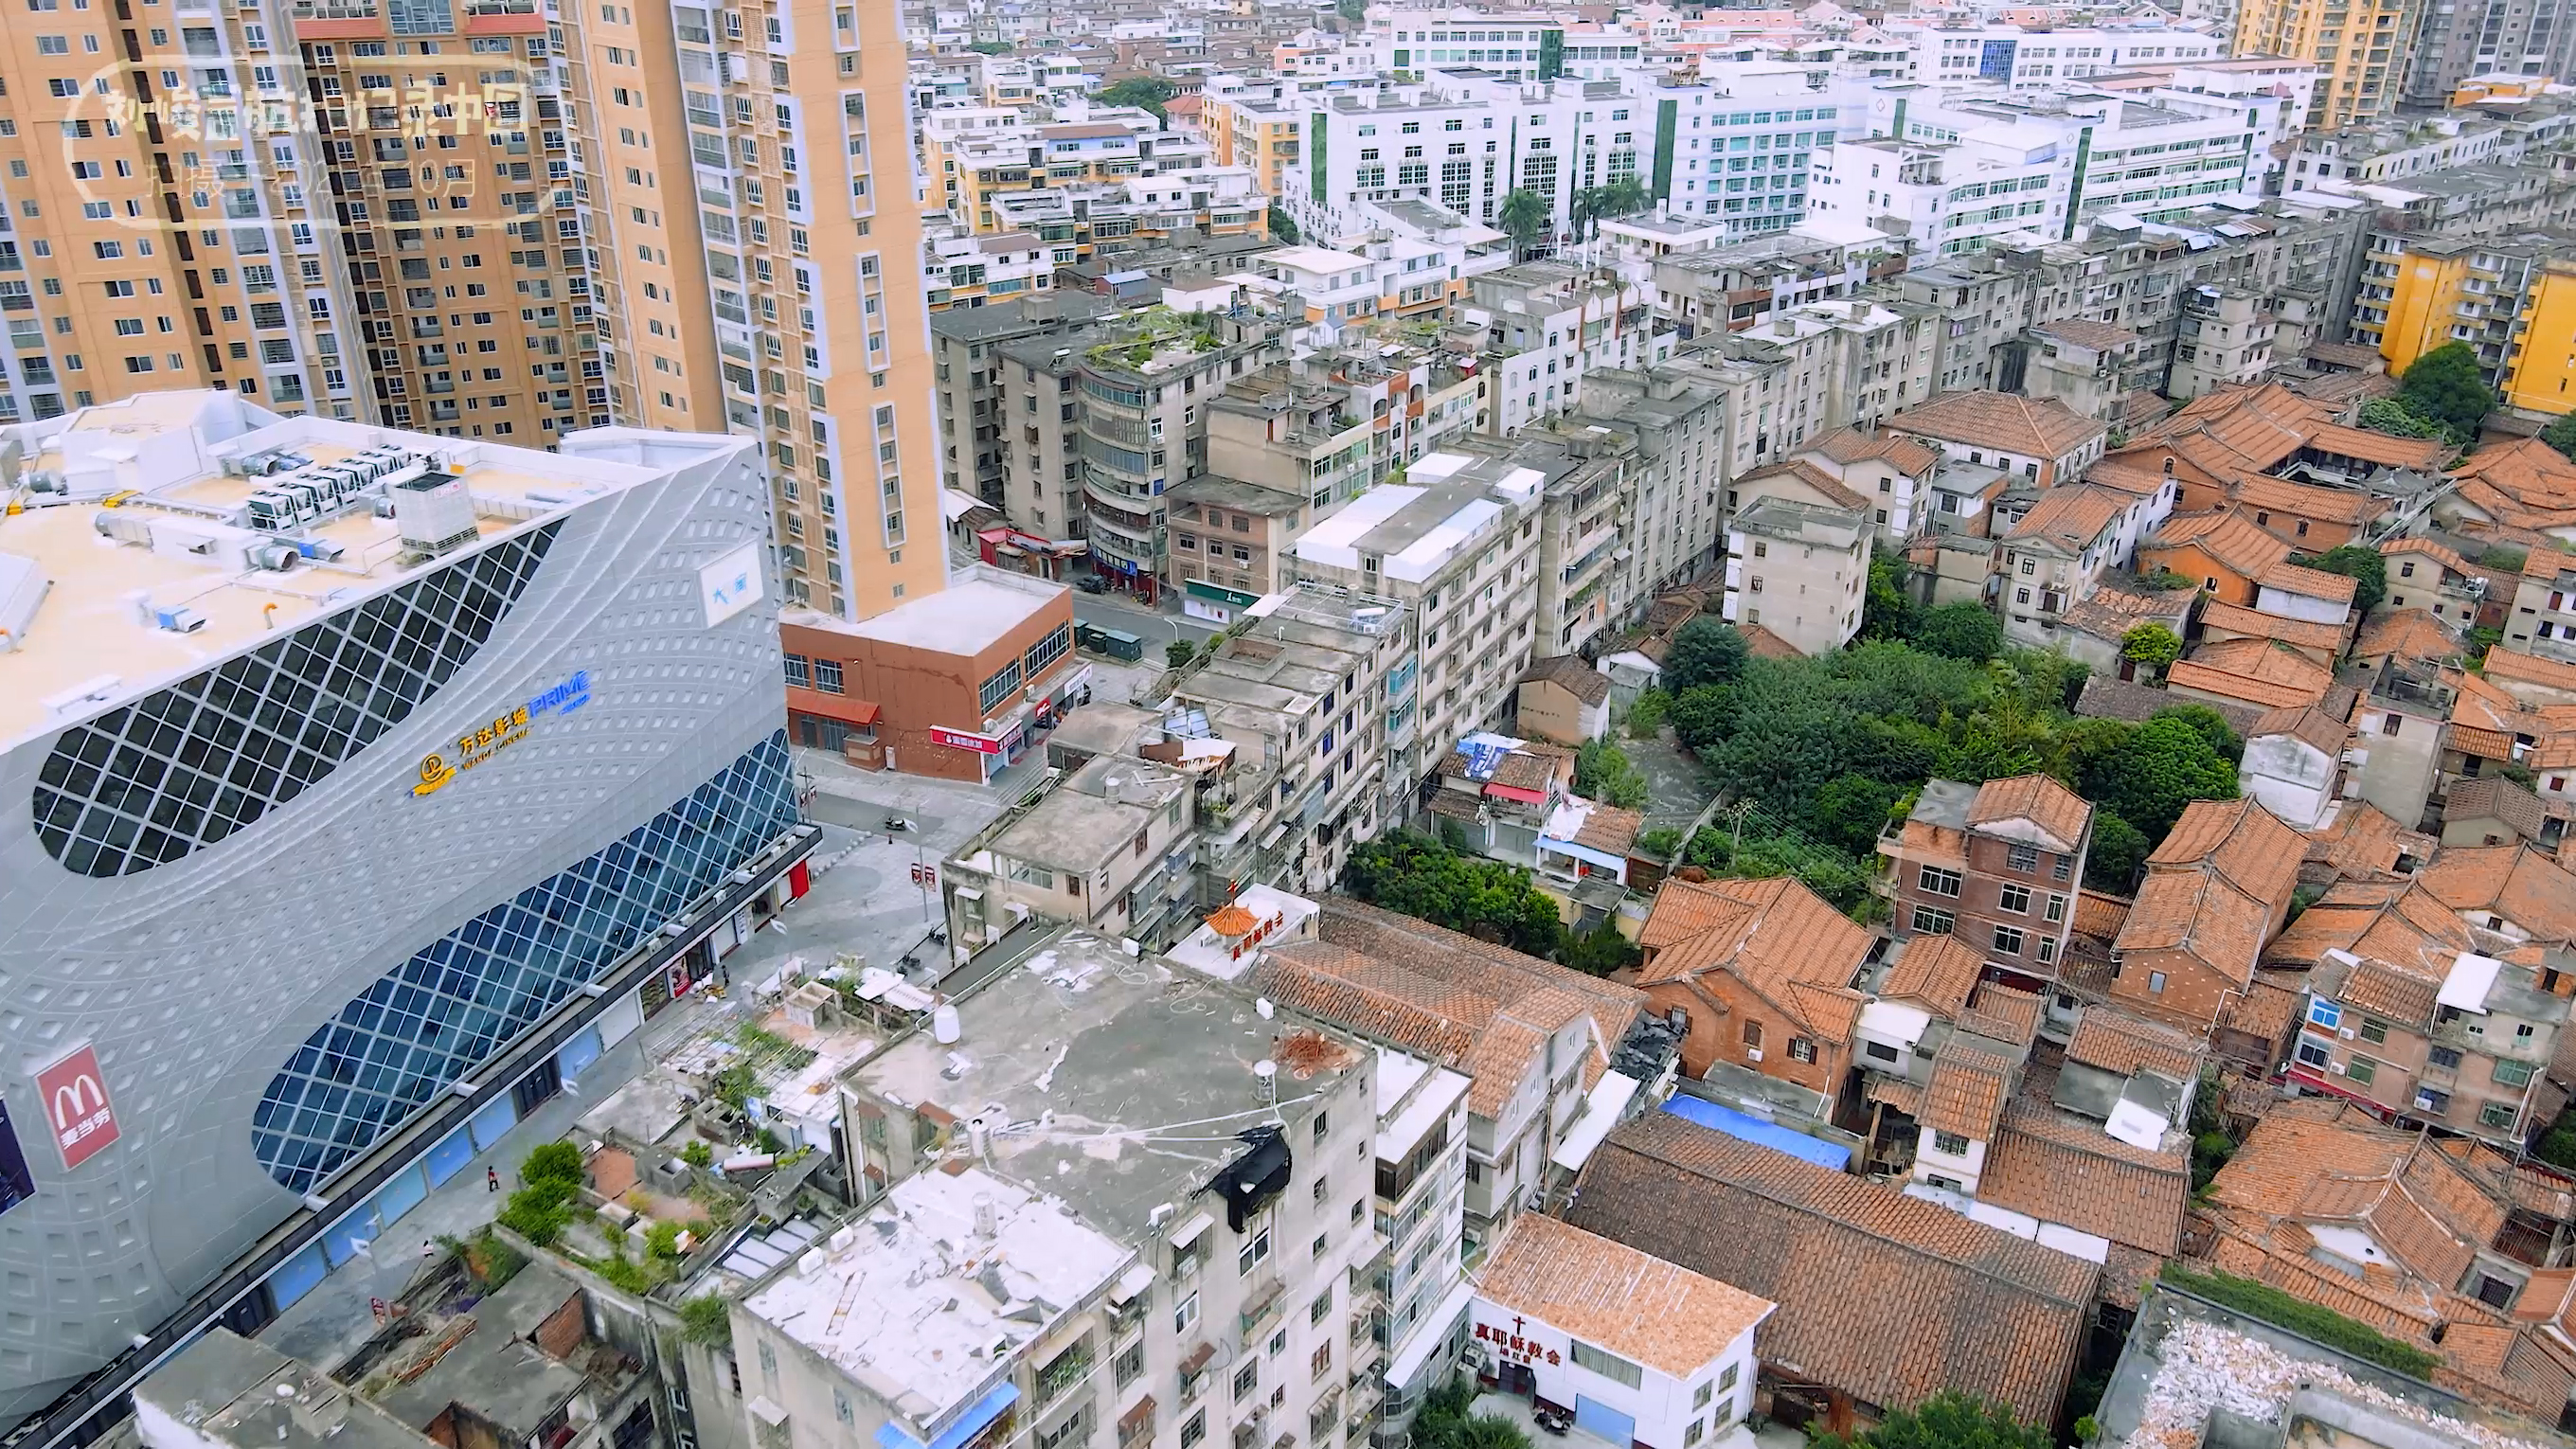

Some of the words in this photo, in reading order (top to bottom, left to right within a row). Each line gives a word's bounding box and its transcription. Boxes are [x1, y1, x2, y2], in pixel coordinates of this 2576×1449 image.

[529, 670, 590, 718] PRIME
[458, 706, 528, 757] 万达影城
[60, 1106, 112, 1150] 麦当劳
